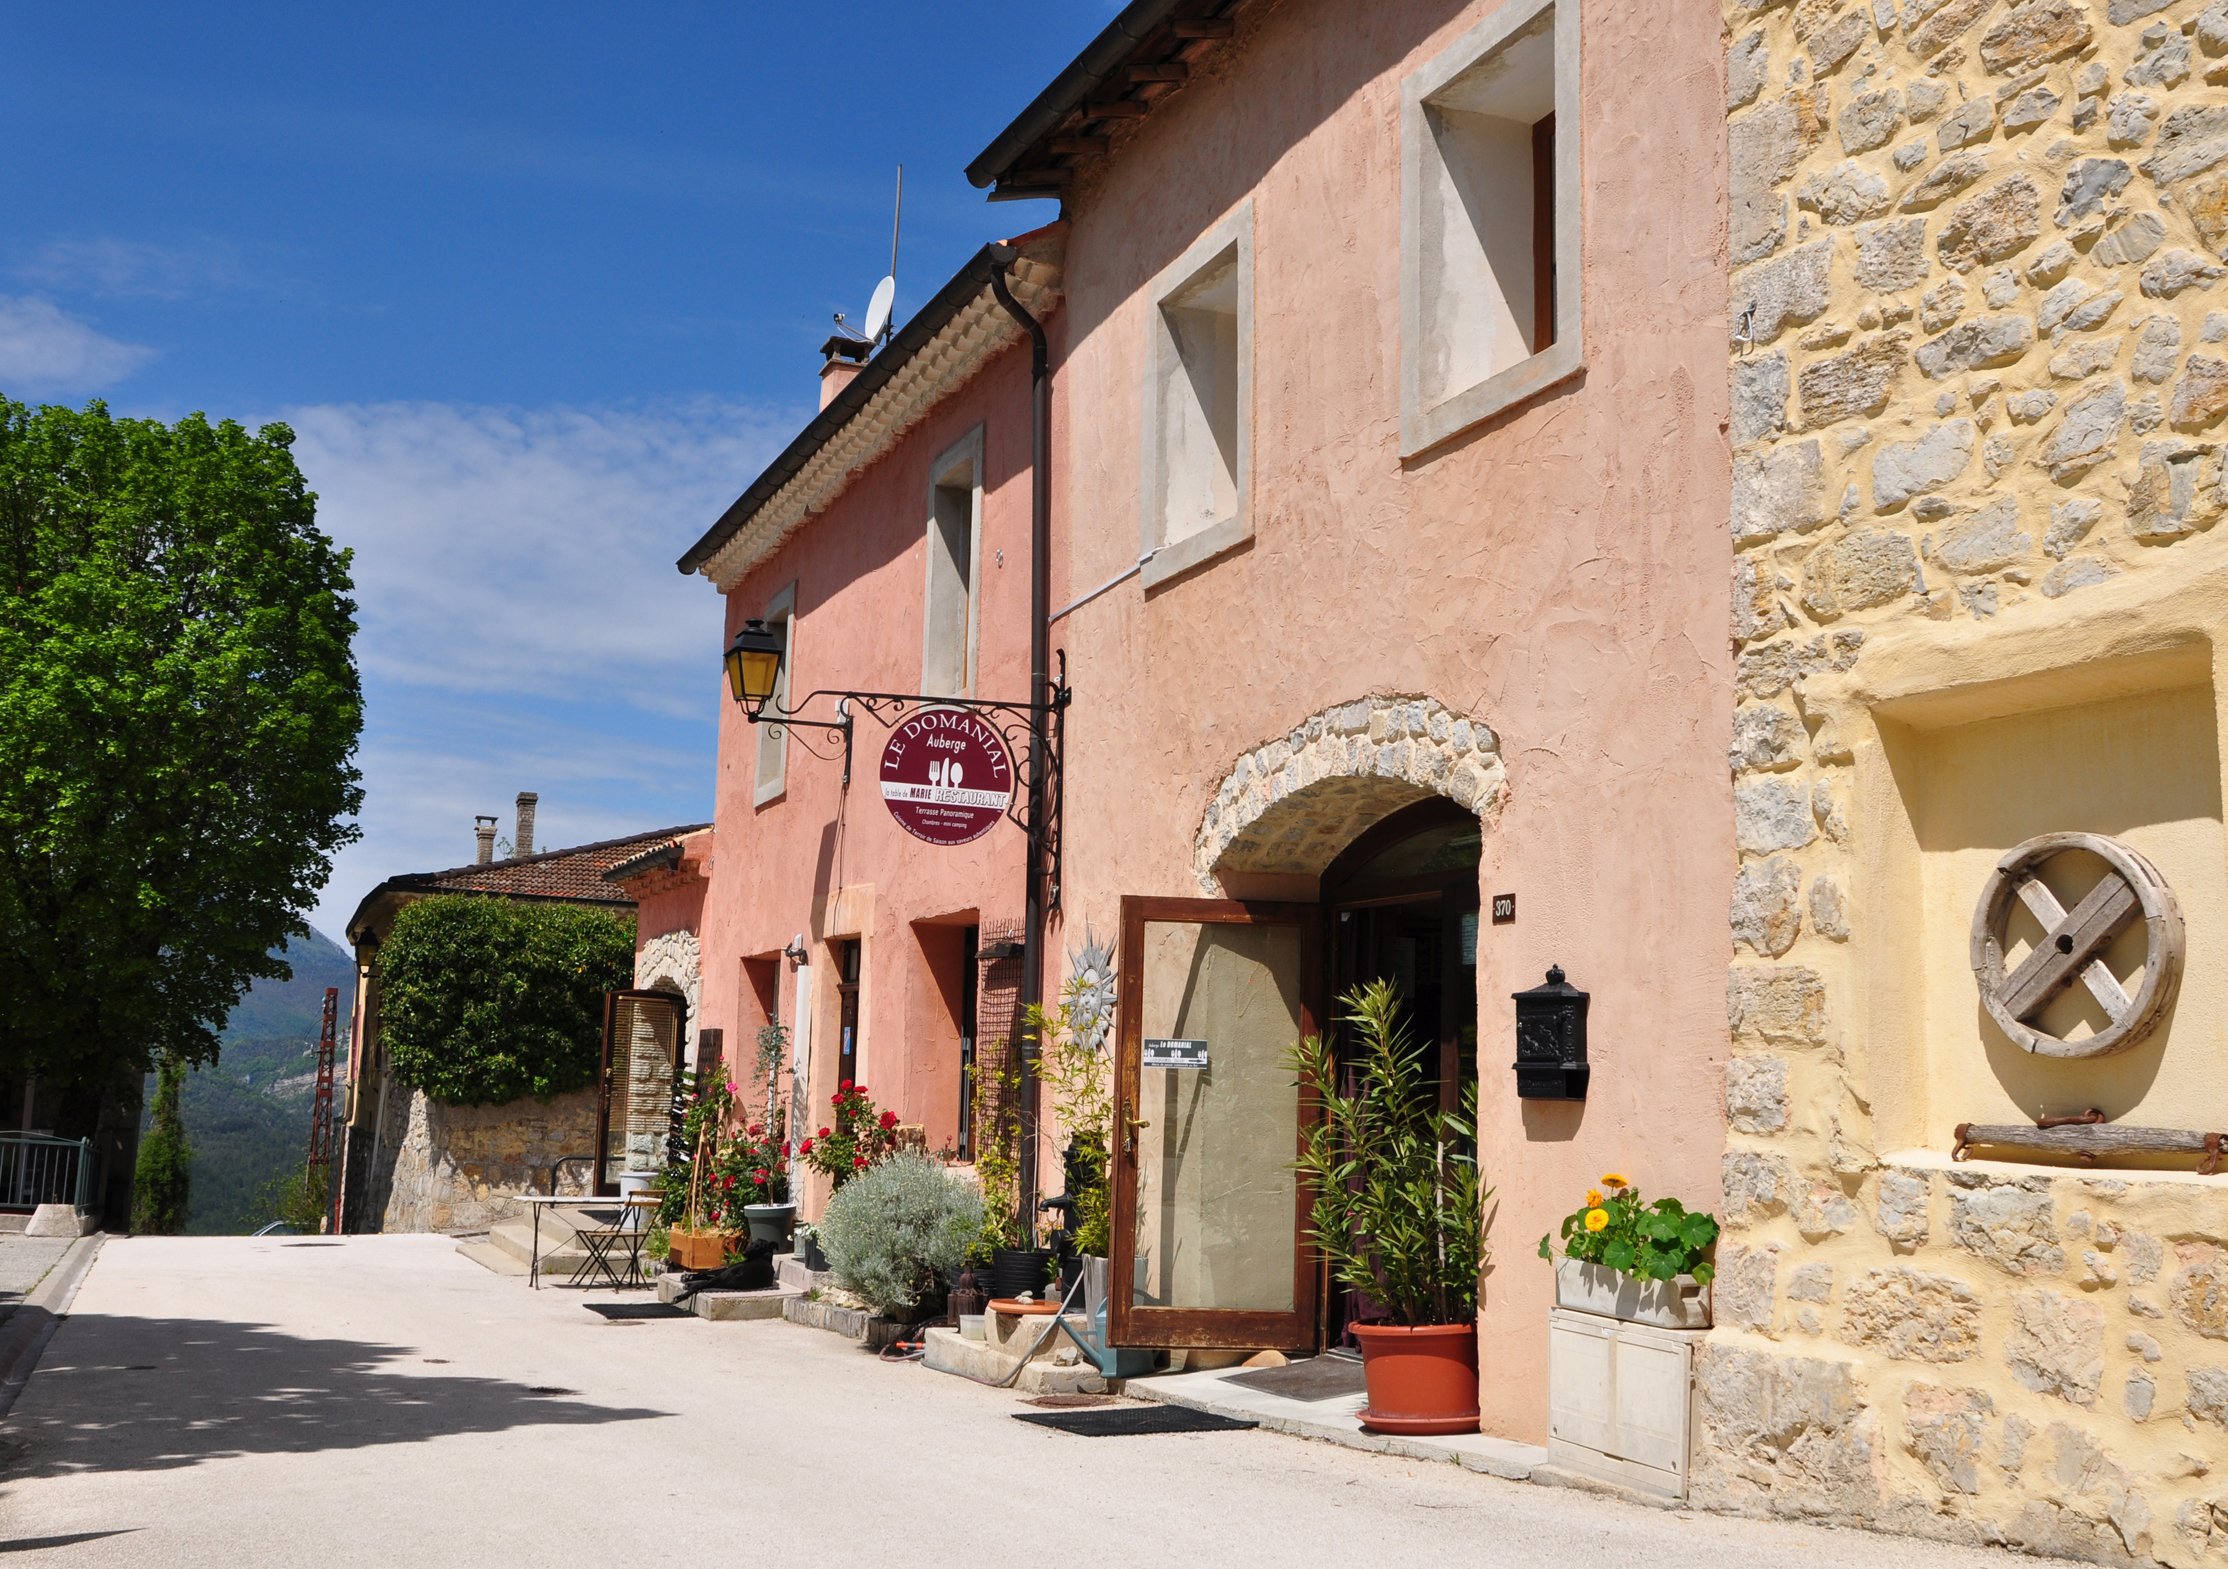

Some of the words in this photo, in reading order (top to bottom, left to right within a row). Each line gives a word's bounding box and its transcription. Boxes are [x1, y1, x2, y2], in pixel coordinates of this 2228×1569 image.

[884, 738, 906, 770] LE
[903, 713, 1007, 779] DOMANIAL
[926, 733, 966, 753] Auberge
[910, 787, 932, 800] MARIE
[935, 788, 1006, 807] RESTAURANT
[915, 806, 939, 816] Terrasse
[940, 808, 975, 820] Panoramique
[1495, 899, 1511, 917] 370
